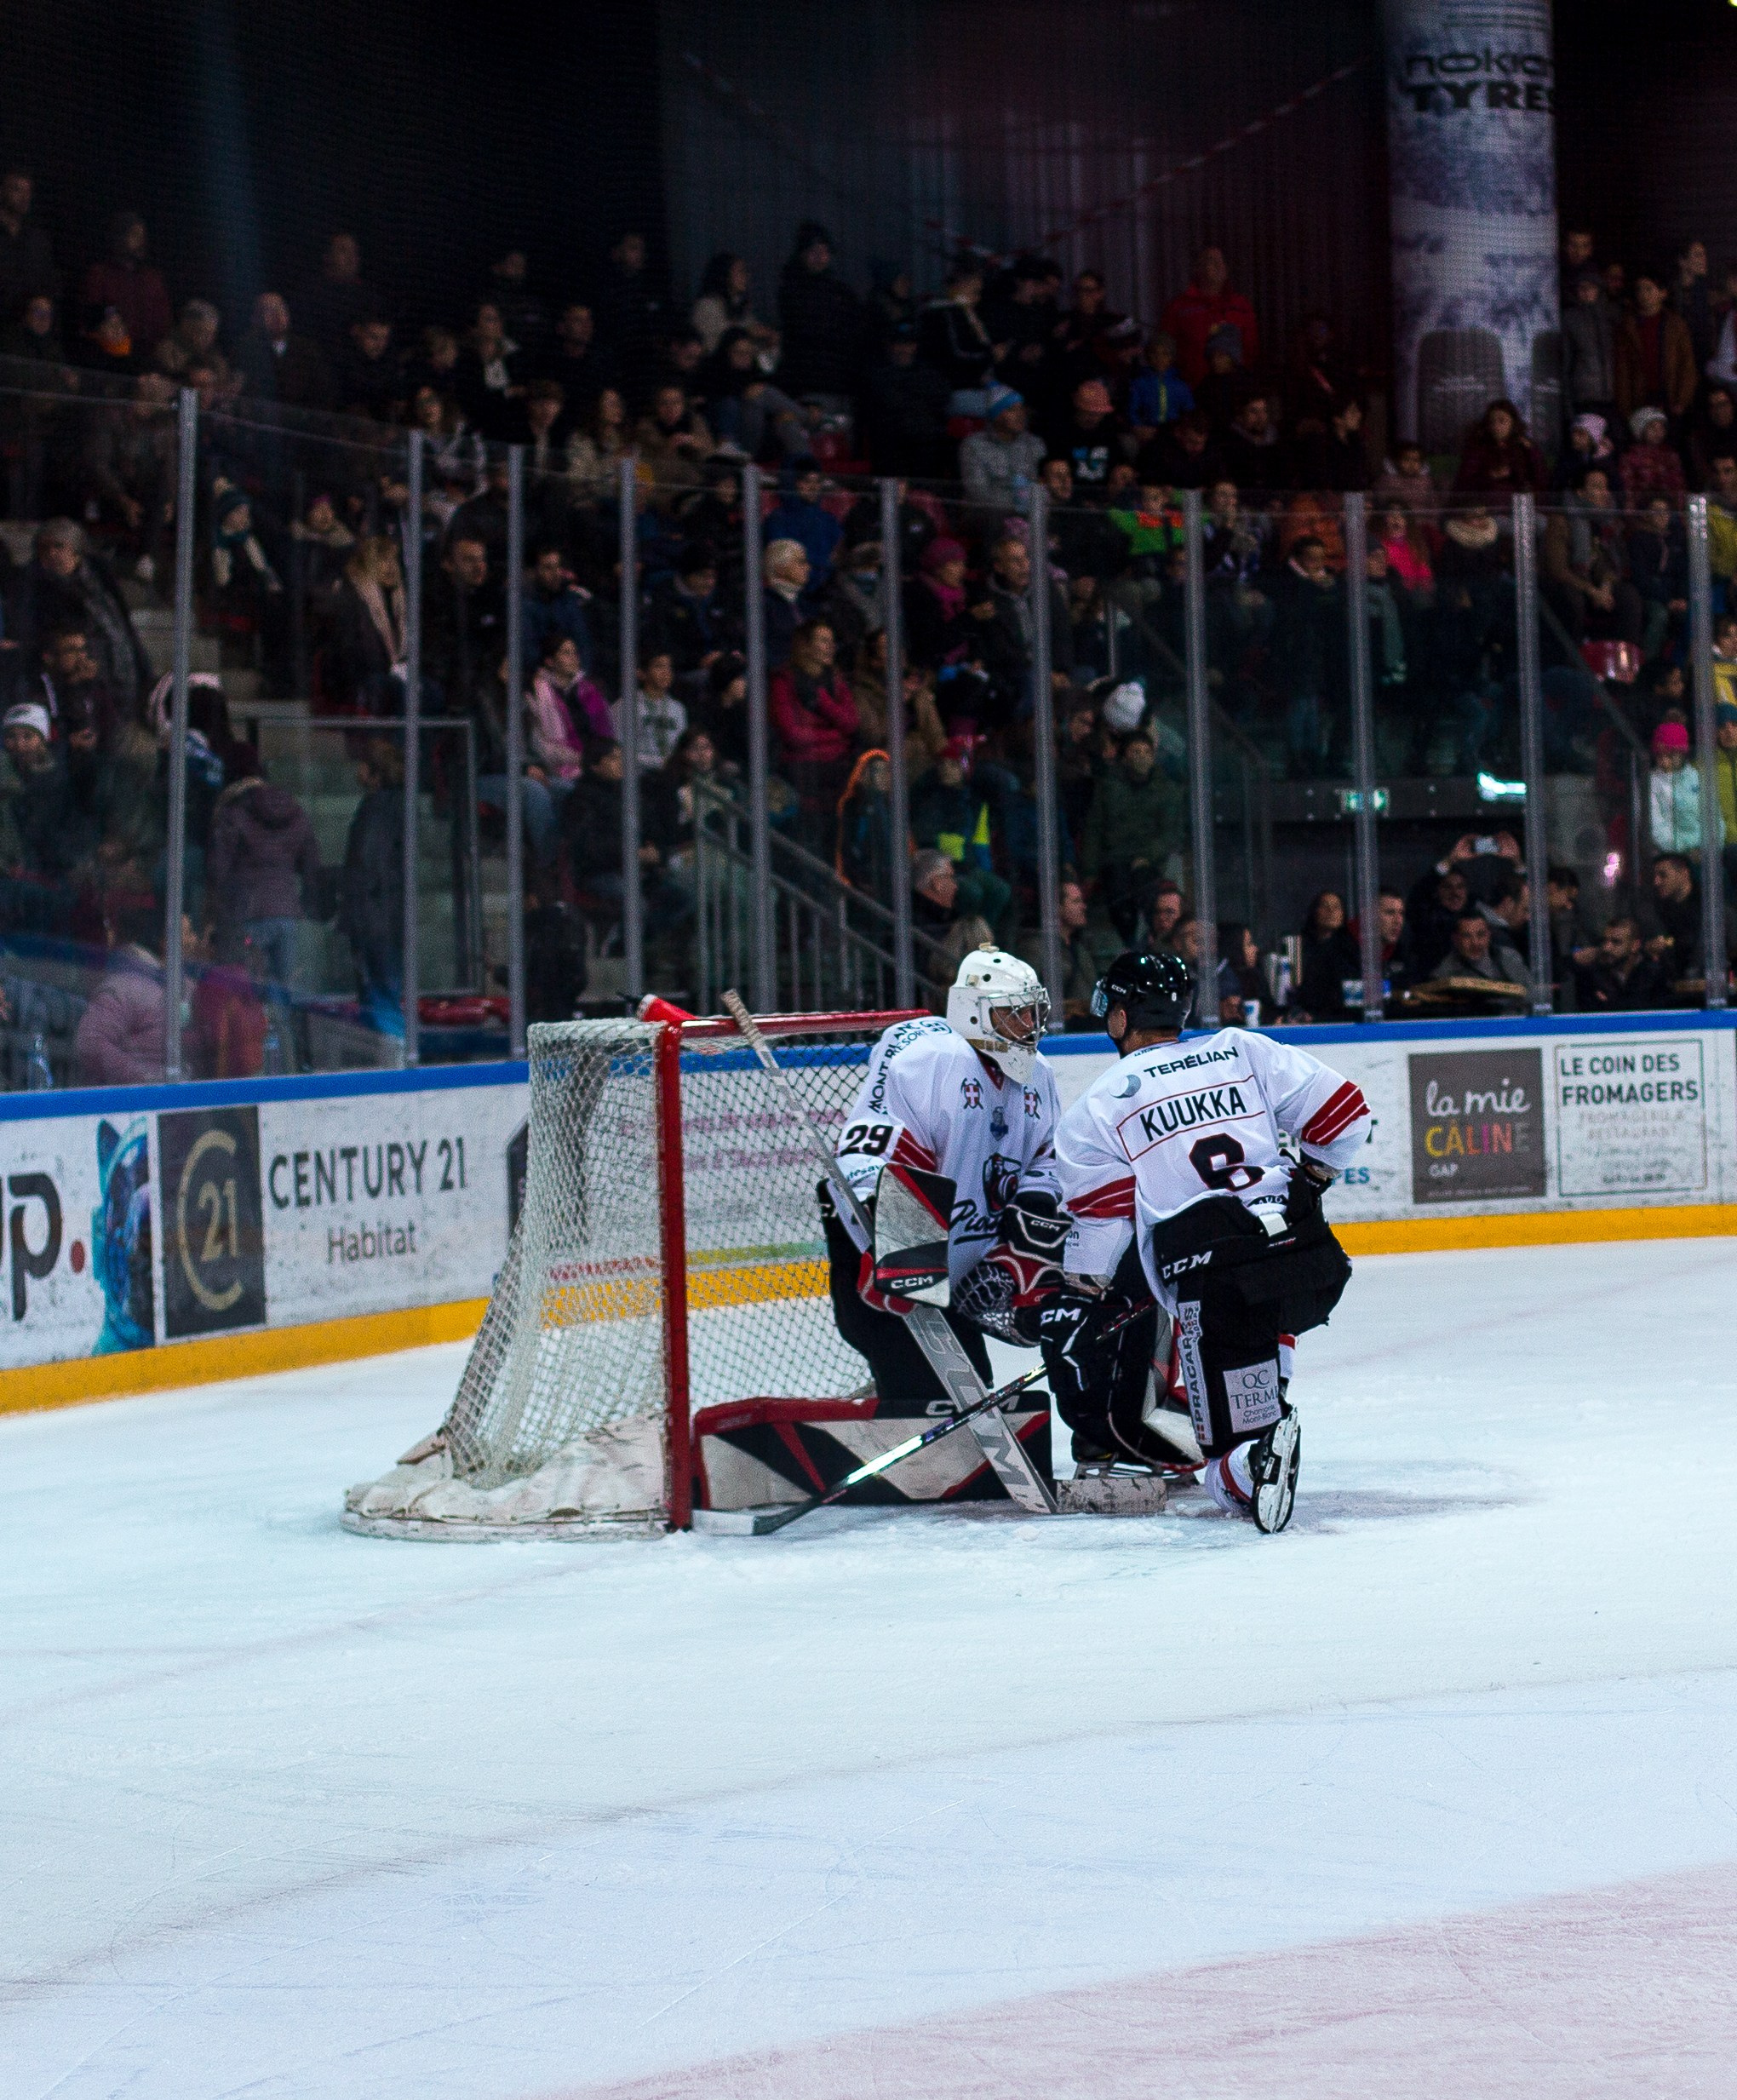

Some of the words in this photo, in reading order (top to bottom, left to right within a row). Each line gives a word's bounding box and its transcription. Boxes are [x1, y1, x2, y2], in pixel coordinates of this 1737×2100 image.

[1407, 48, 1554, 75] nokia
[1144, 1046, 1239, 1077] TERÉLIAN
[1560, 1058, 1584, 1076] LE
[1589, 1055, 1636, 1075] COIN
[1642, 1053, 1680, 1073] DES
[868, 1061, 888, 1113] MONT
[1425, 1079, 1460, 1117] la
[1465, 1077, 1532, 1115] mie
[1562, 1079, 1699, 1105] FROMAGERS
[1139, 1086, 1247, 1142] KUUKKA
[840, 1124, 894, 1157] 29
[268, 1139, 428, 1209] CENTURY
[437, 1136, 466, 1191] 21
[1030, 1219, 1061, 1232] CCM
[327, 1219, 416, 1265] Habitat
[1161, 1250, 1213, 1280] CCM
[891, 1276, 933, 1289] CCM
[1243, 1369, 1270, 1389] QC
